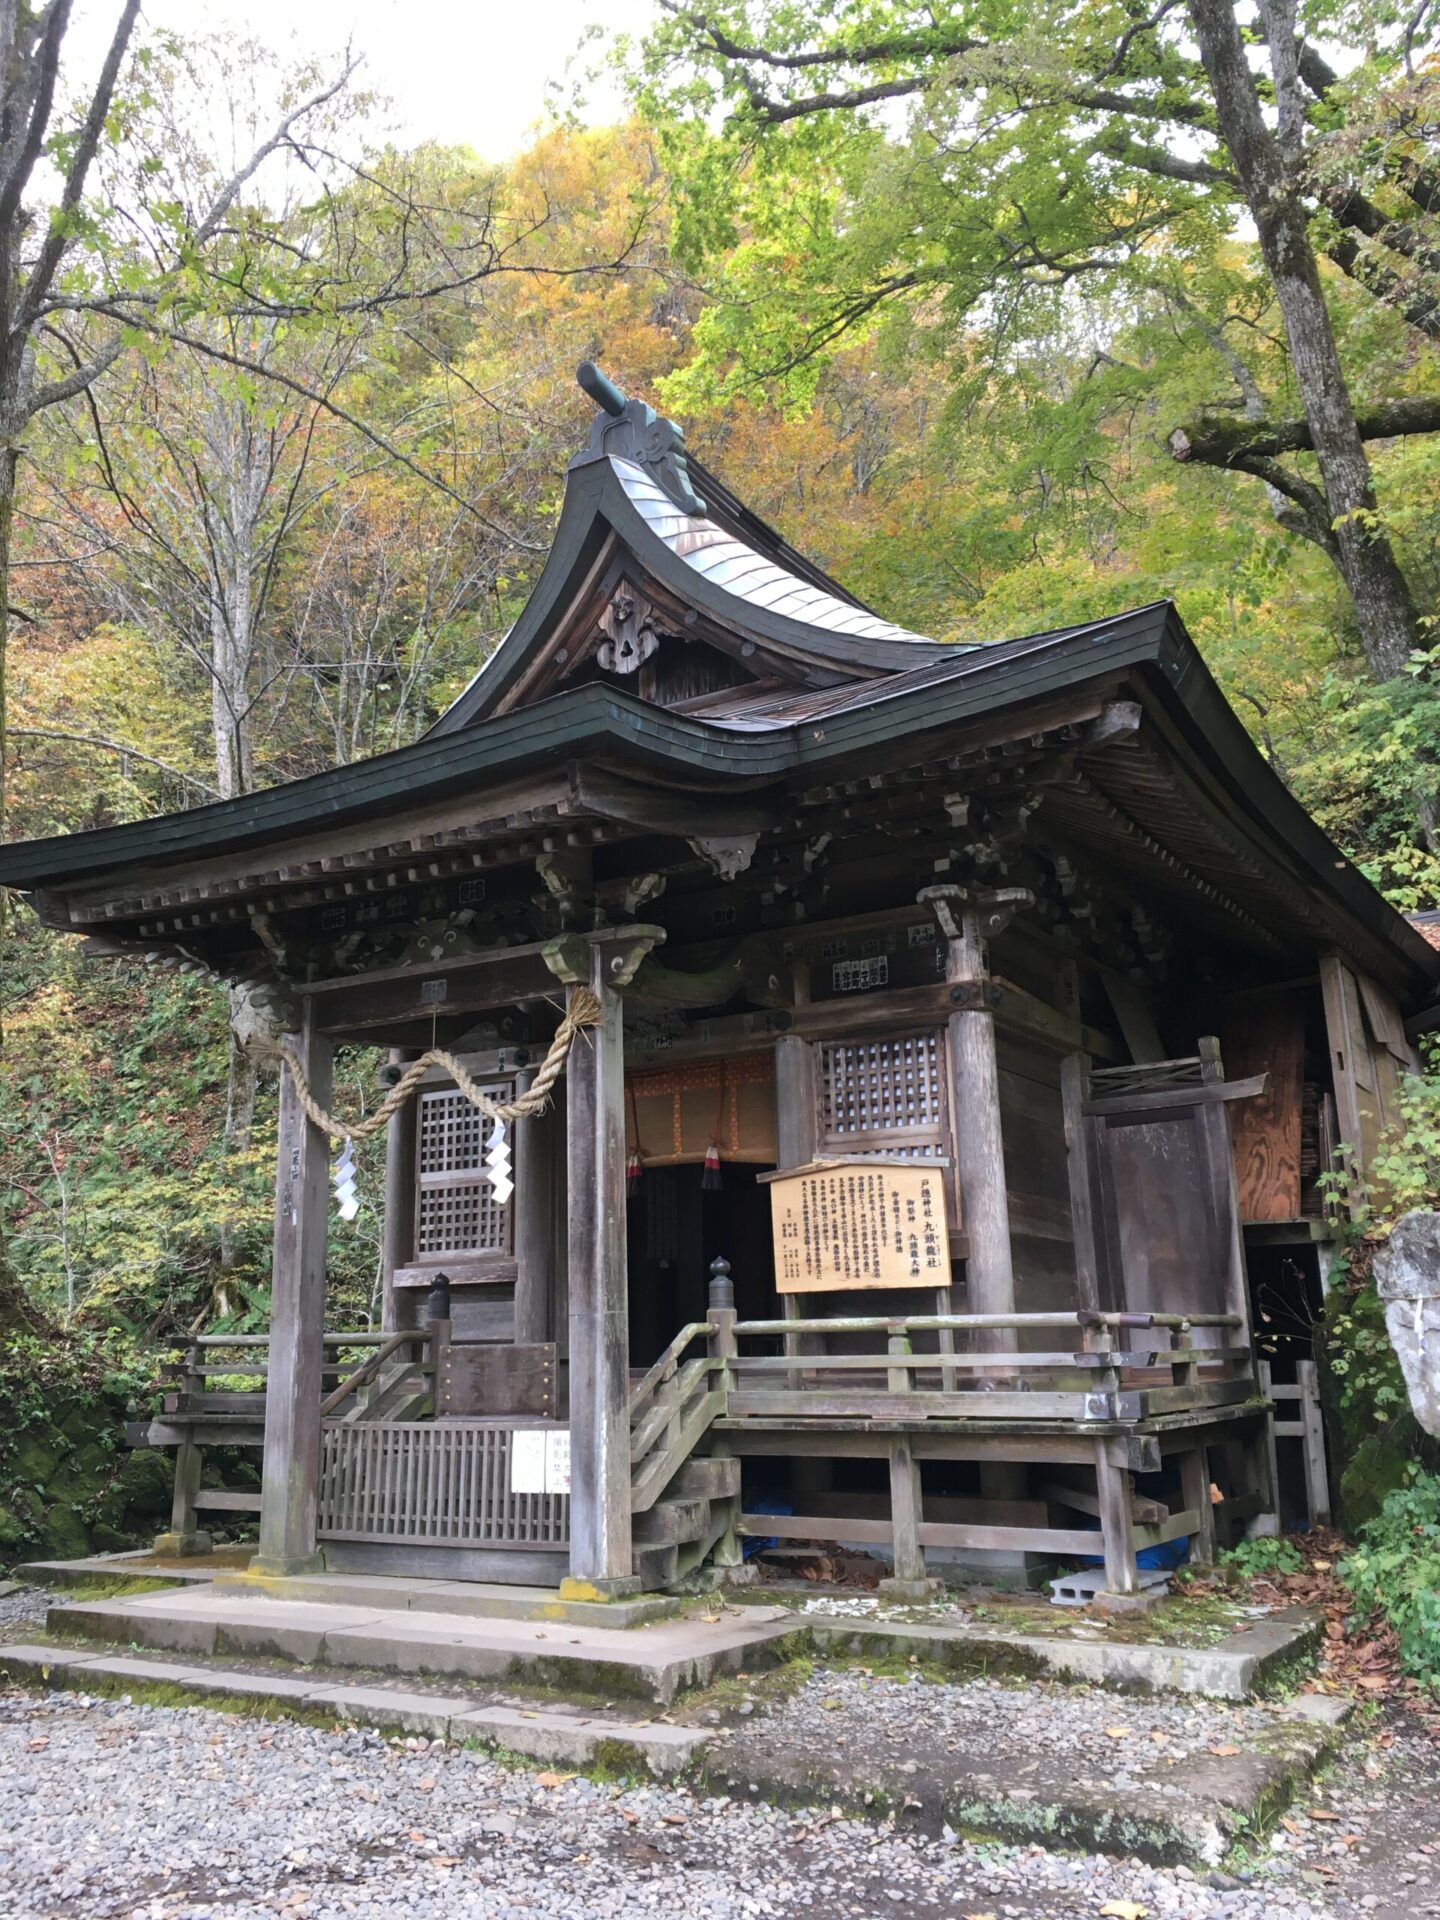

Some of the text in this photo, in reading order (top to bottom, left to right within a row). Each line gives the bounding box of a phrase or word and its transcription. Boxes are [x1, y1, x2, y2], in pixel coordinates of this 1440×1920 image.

[908, 1232, 920, 1276] 九頭龍大神
[920, 1178, 938, 1268] 戸隠神社 九頭龍社
